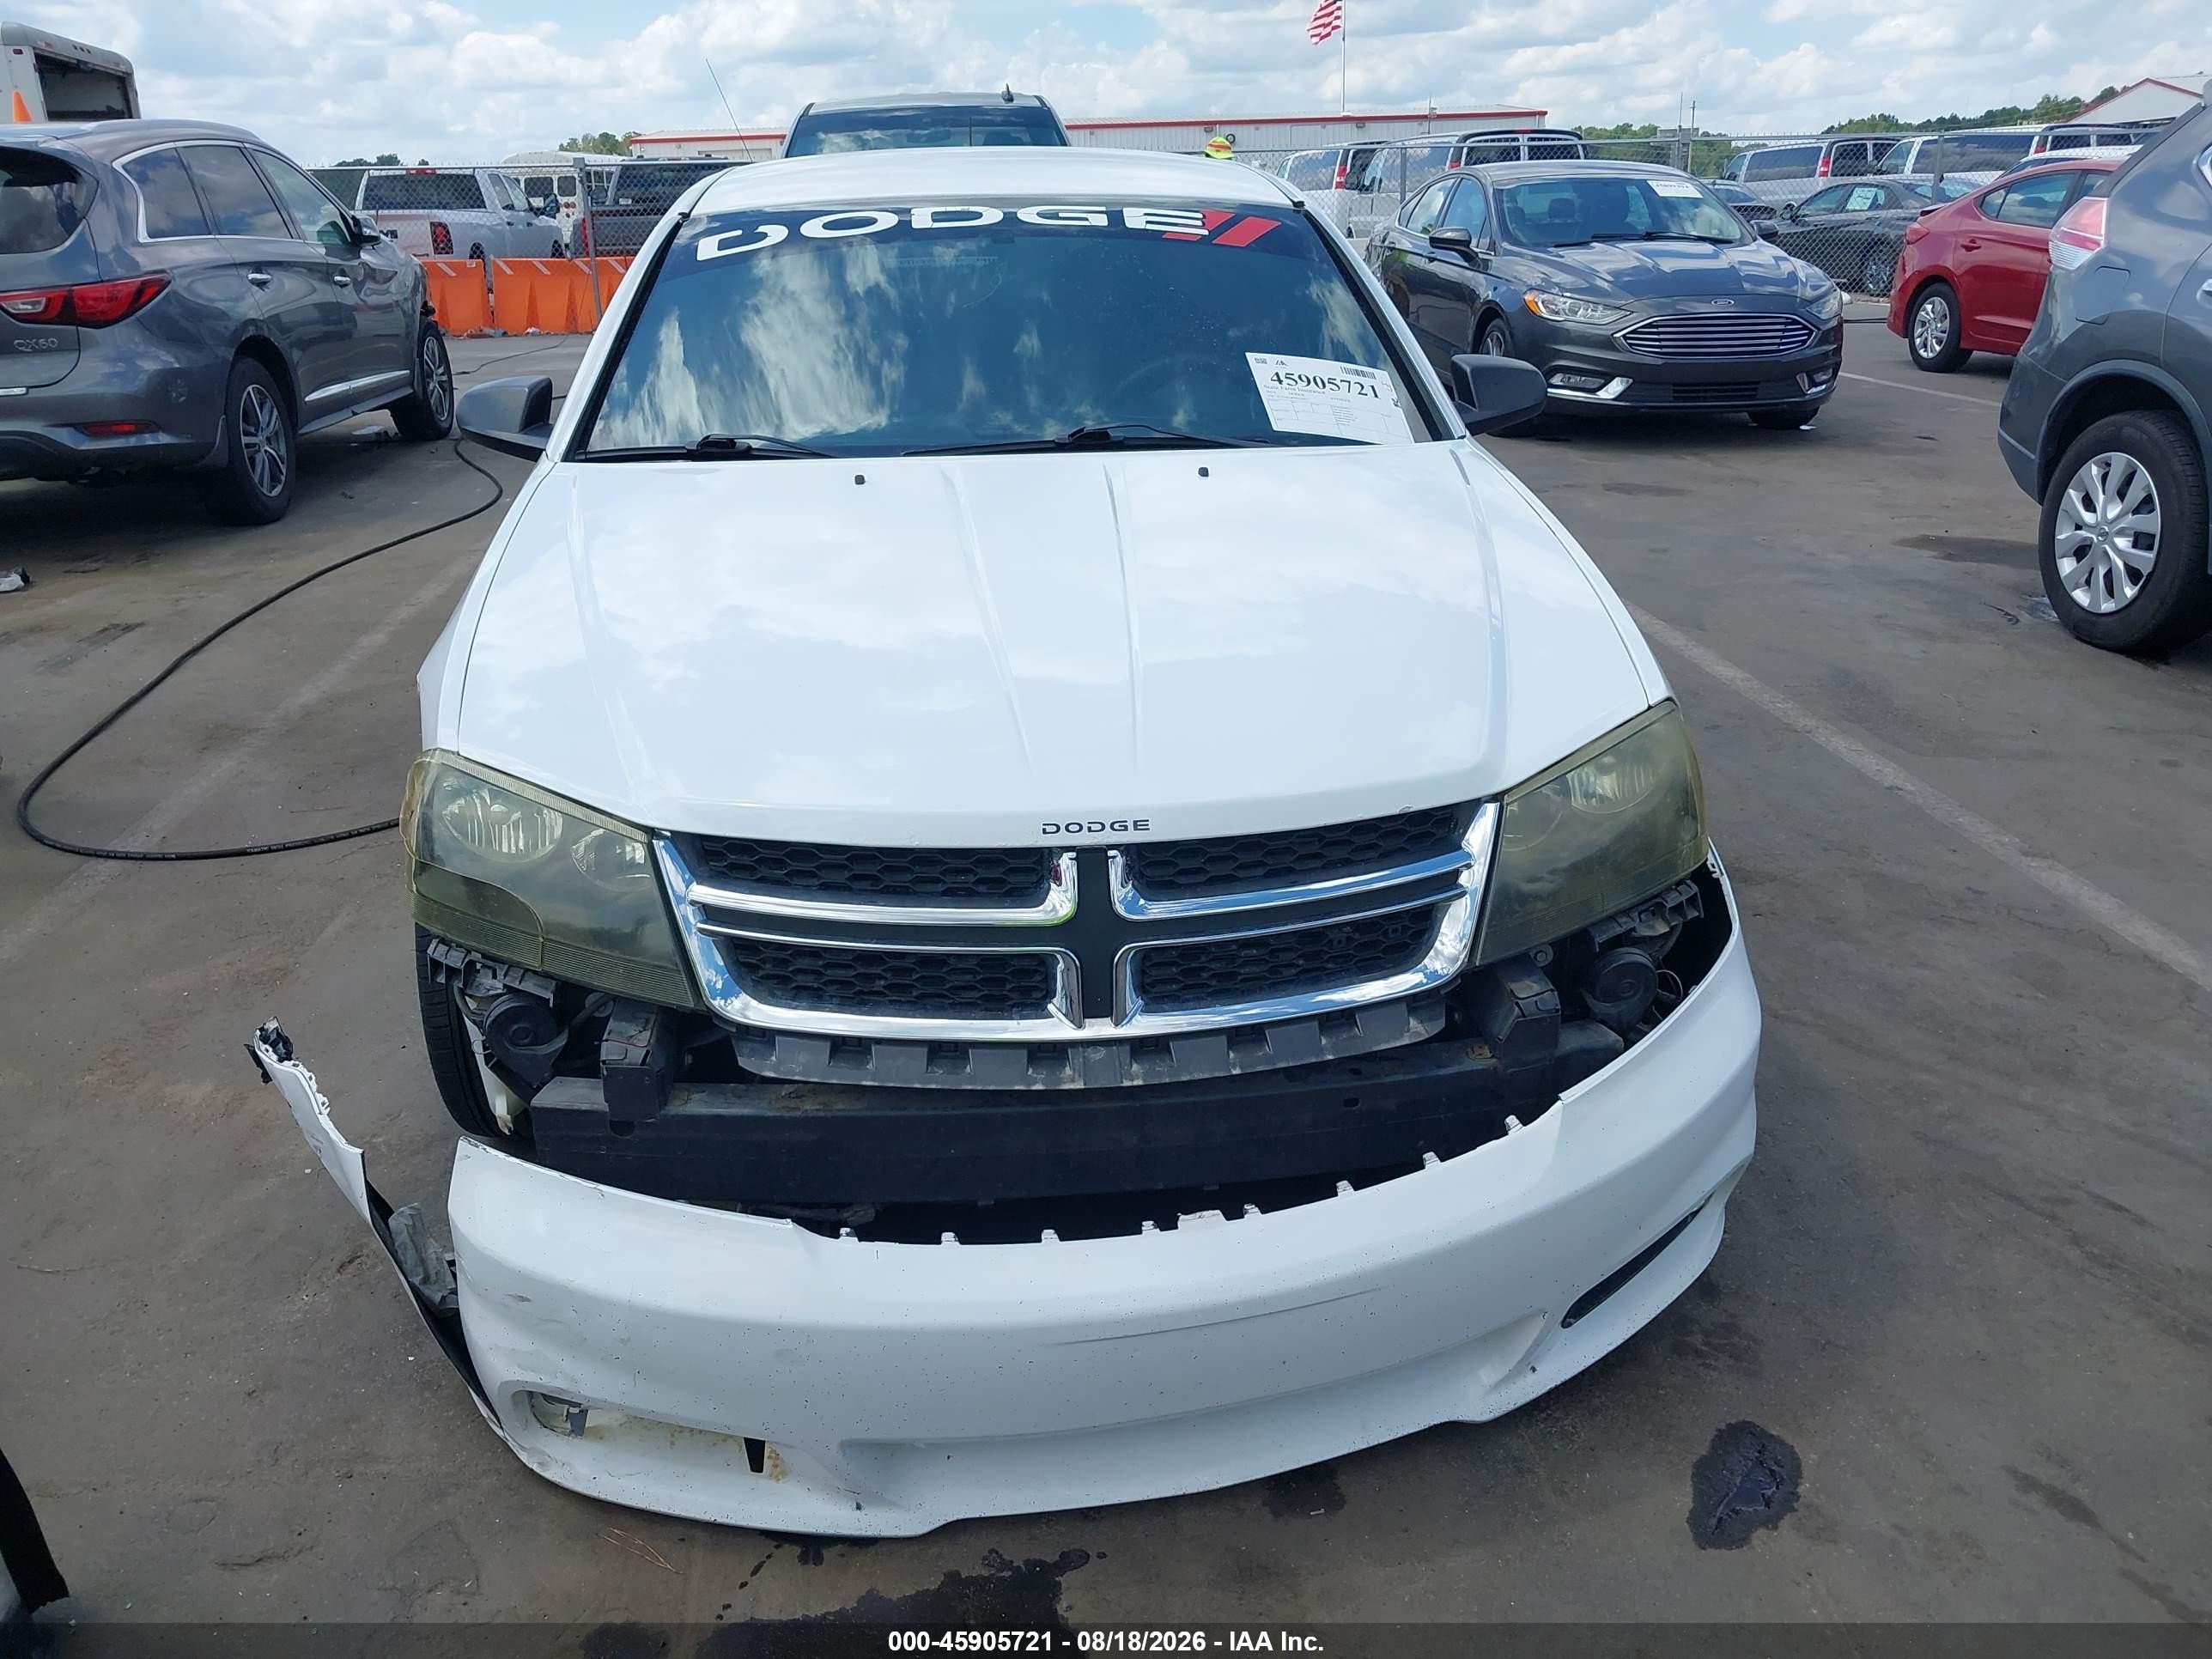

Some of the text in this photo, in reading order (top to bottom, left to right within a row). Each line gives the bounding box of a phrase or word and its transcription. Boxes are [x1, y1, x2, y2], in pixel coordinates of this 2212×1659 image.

[696, 205, 1211, 261] DODGE
[13, 337, 58, 352] QX60
[1270, 371, 1381, 399] 45905721
[1042, 819, 1151, 836] DODGE
